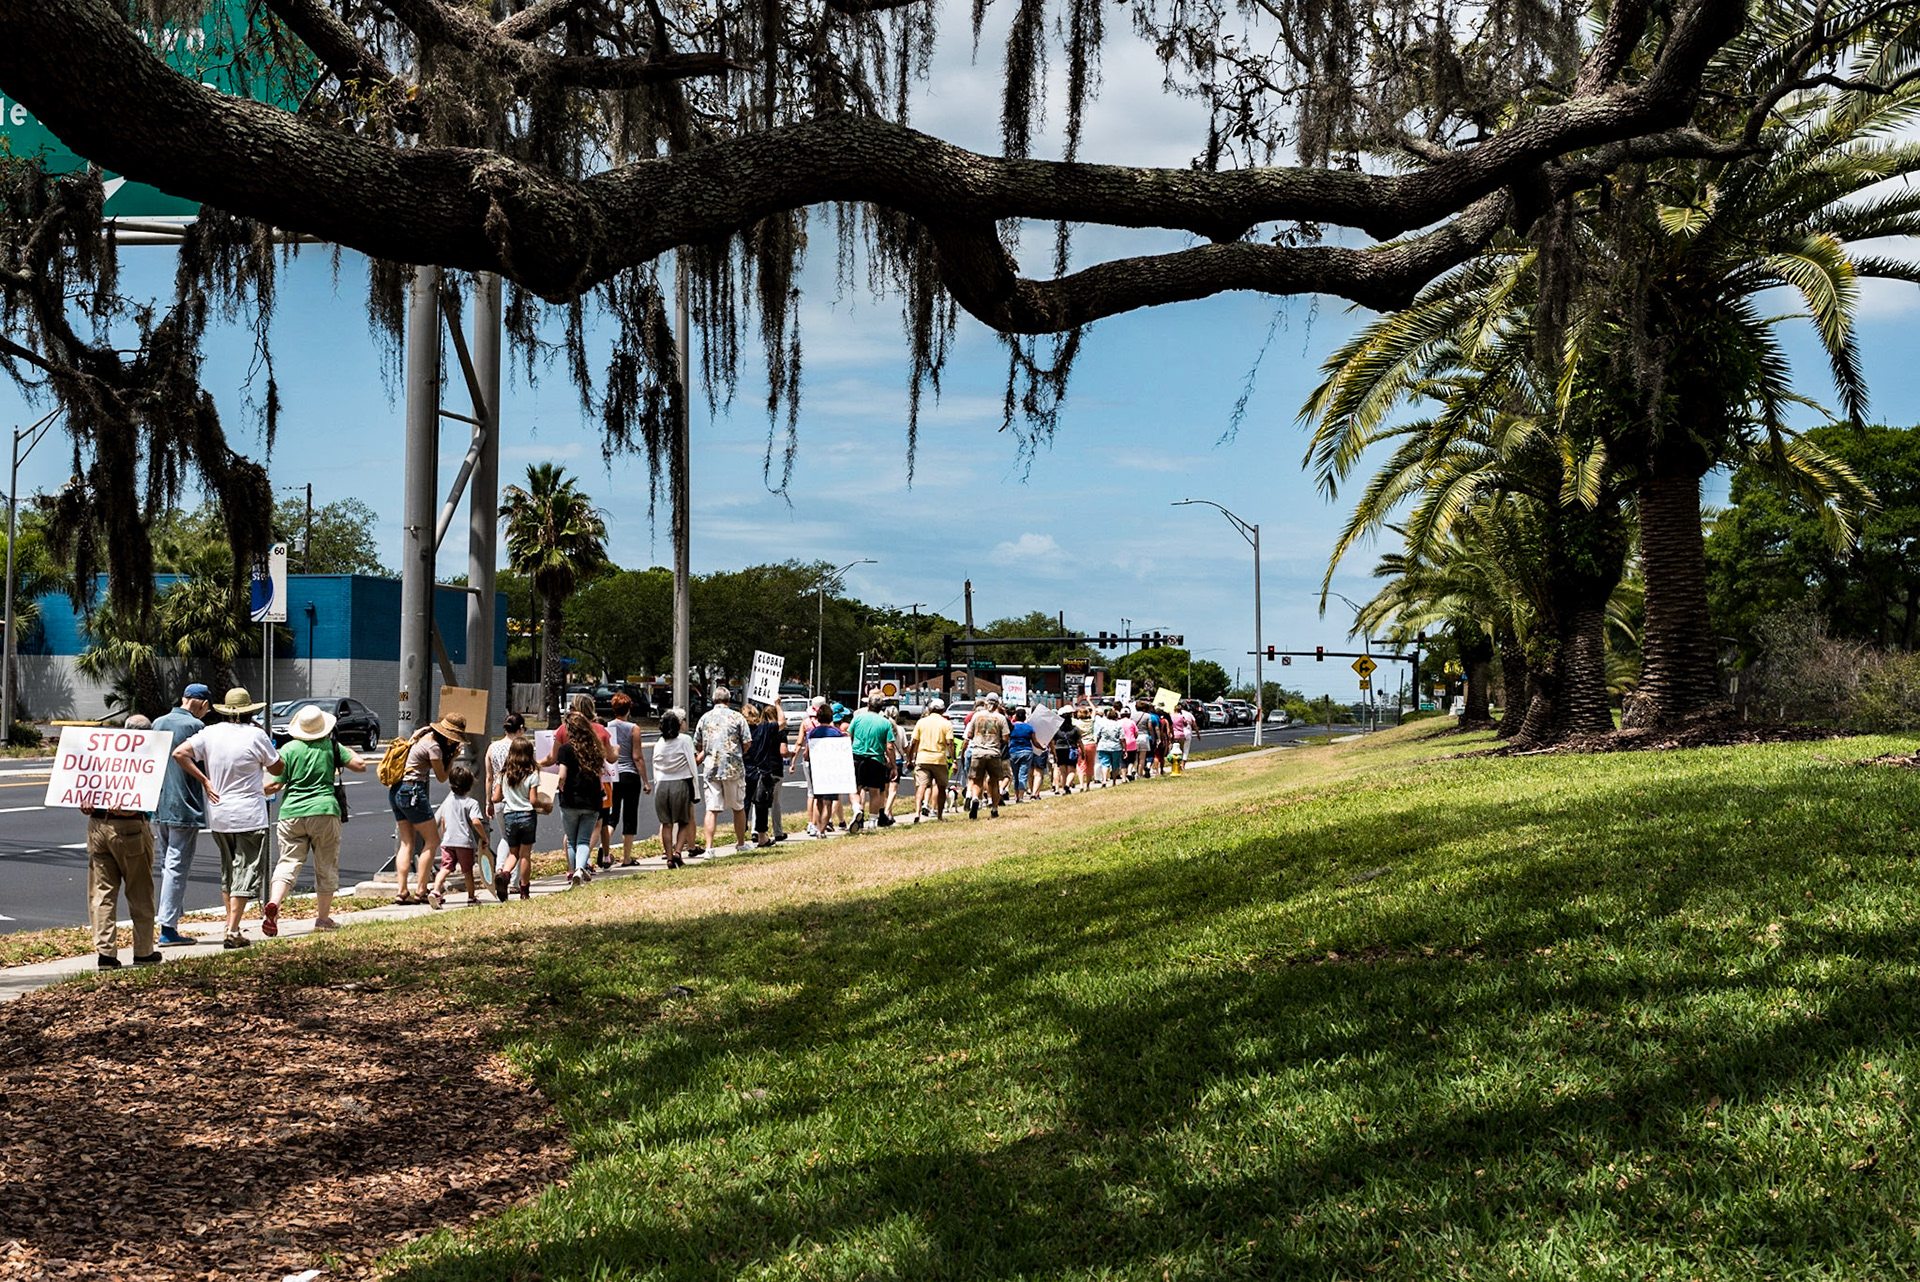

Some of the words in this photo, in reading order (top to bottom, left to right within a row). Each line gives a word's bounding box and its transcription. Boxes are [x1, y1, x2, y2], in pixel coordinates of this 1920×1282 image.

[274, 546, 285, 555] 60
[758, 654, 782, 668] GLOBAL
[761, 677, 768, 687] IS
[753, 686, 770, 699] REAL
[87, 733, 145, 752] STOP
[63, 754, 155, 774] DUMBING
[75, 774, 136, 790] DOWN
[61, 789, 142, 808] AMERICA
